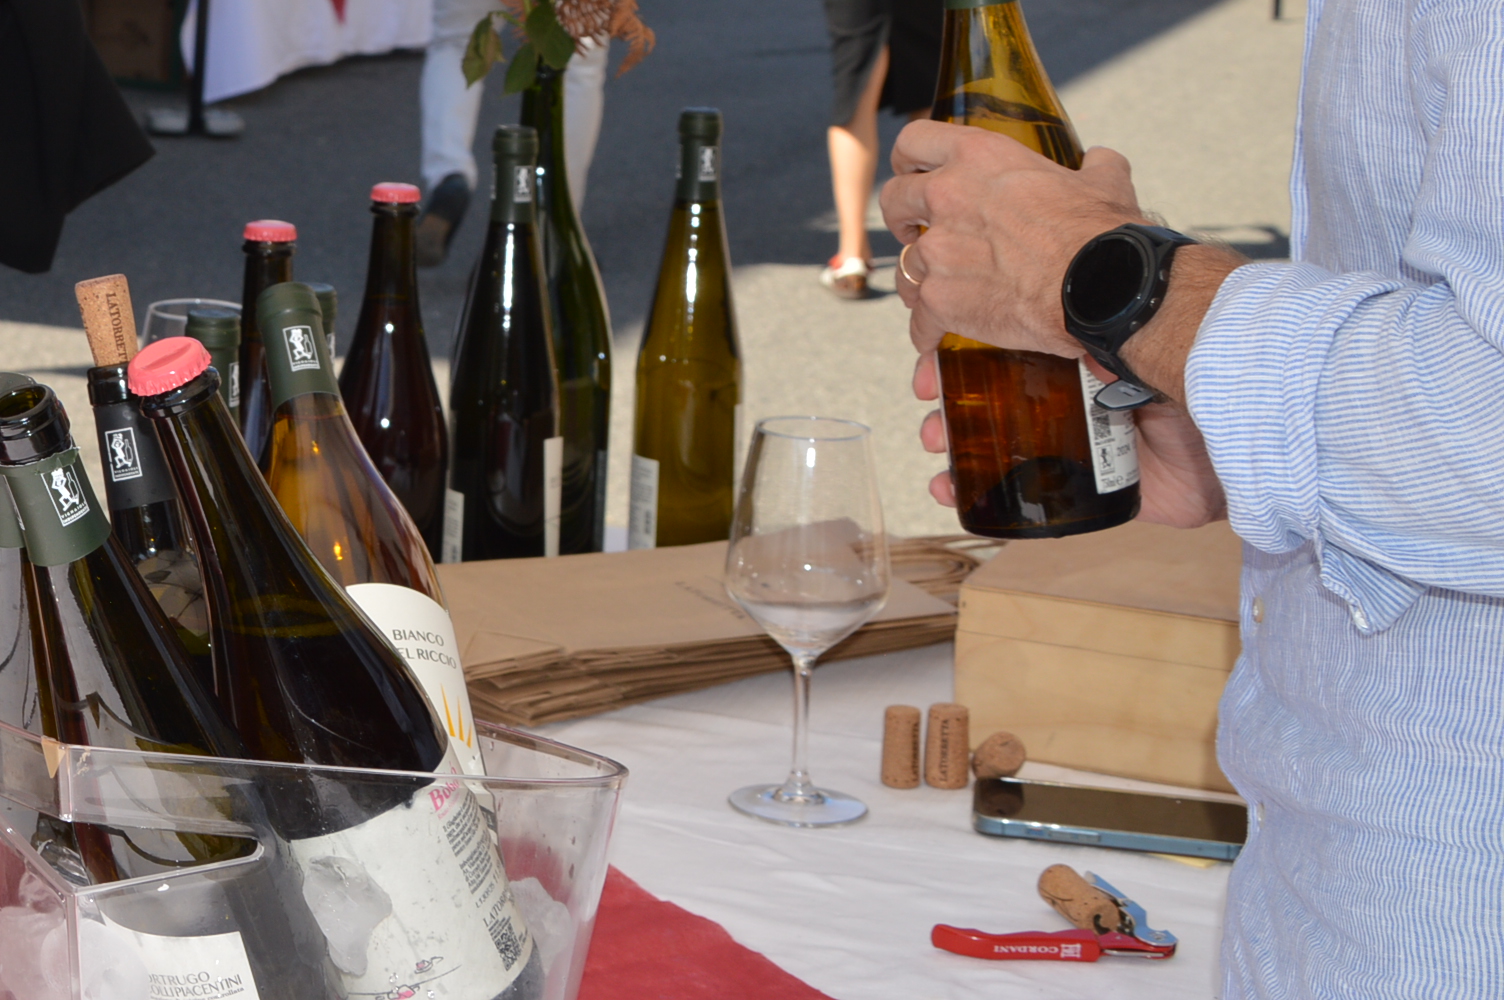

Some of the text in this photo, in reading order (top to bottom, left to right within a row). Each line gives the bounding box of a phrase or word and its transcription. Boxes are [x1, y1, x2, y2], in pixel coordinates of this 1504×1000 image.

[105, 293, 128, 361] LATORRET
[391, 628, 445, 647] BIANCO
[398, 647, 457, 670] EL RICCIO
[993, 944, 1059, 954] CORDANI
[150, 984, 175, 998] OLLI
